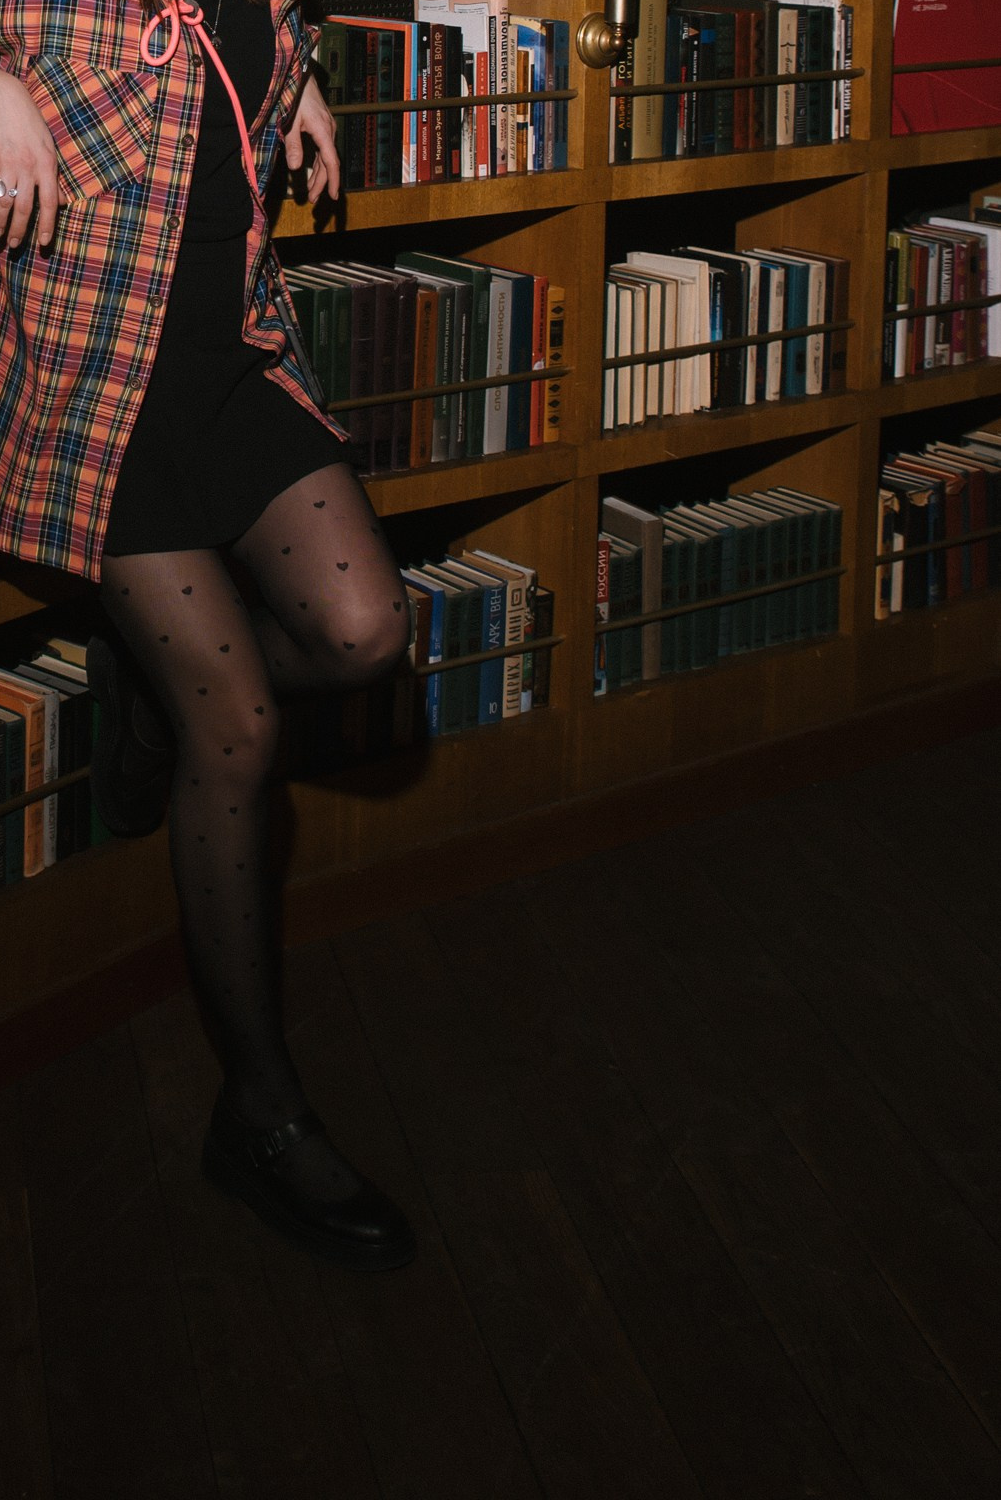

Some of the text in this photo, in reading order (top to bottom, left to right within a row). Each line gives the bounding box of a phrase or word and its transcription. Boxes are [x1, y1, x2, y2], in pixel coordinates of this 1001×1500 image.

[432, 31, 443, 60] ВОЛФ
[500, 20, 508, 83] ВОЛШЕБНОЕ
[420, 68, 428, 95] УРАНУСЕ
[434, 131, 442, 161] Маркус
[494, 292, 506, 361] АНТИЧНОСТИ
[597, 550, 607, 598] РОССИИ
[505, 662, 521, 710] ГЕНРИХ
[488, 701, 498, 715] 10
